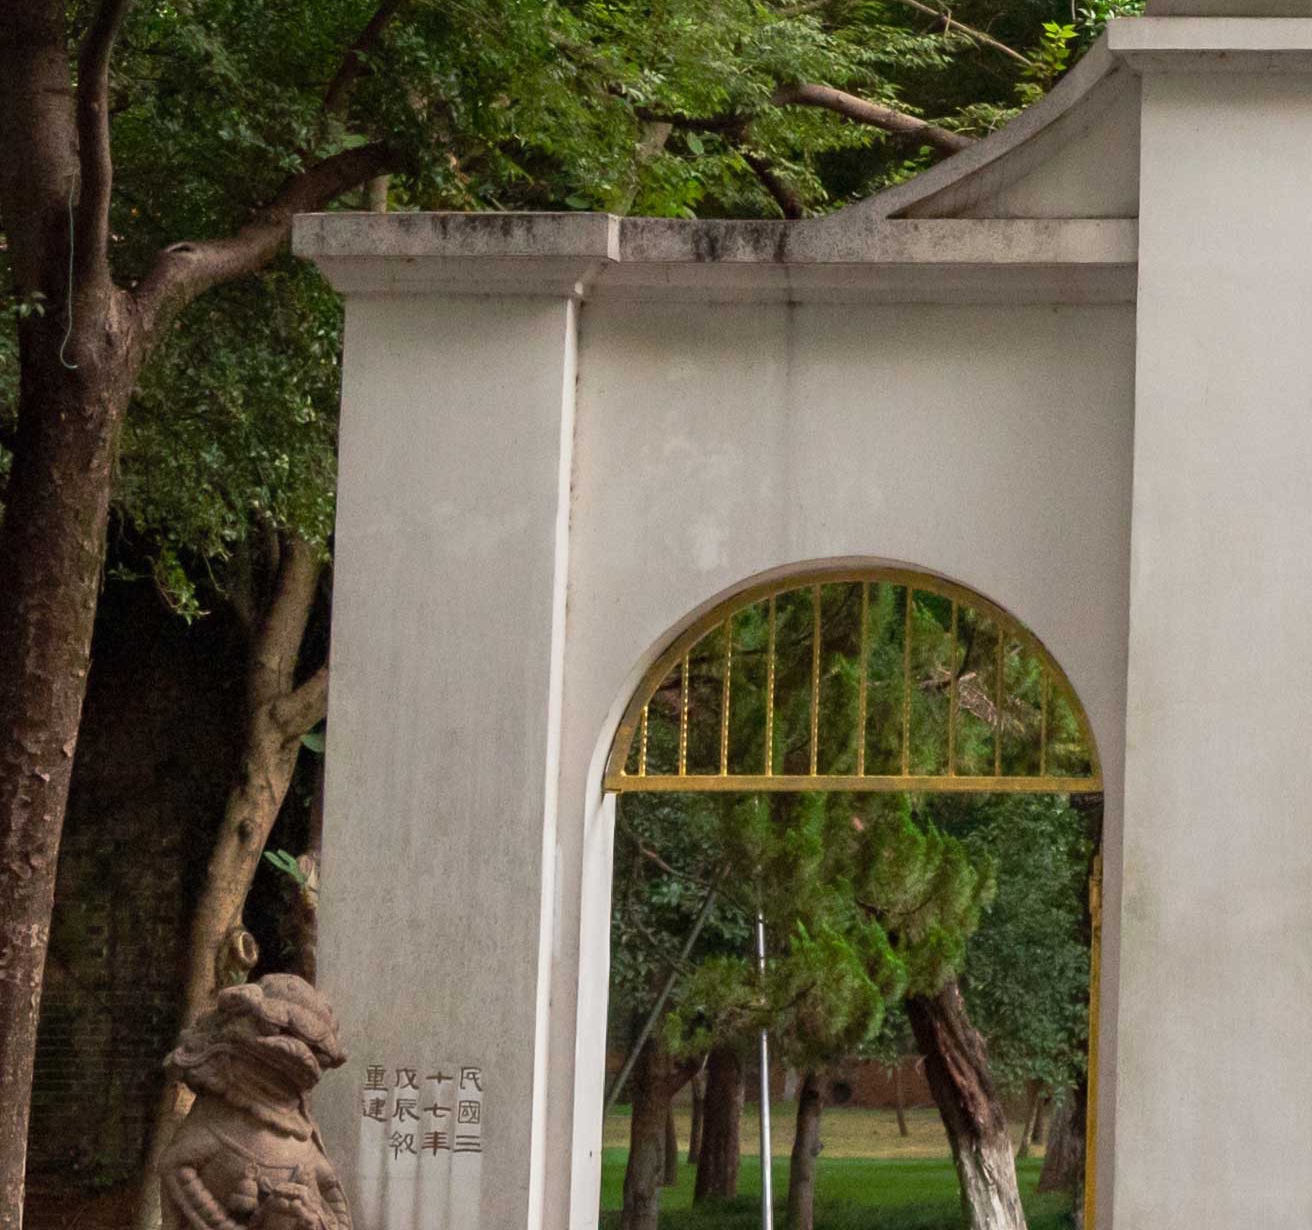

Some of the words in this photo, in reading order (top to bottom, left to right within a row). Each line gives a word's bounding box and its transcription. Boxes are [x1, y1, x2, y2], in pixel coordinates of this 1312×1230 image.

[361, 1064, 388, 1122] 重建
[421, 1071, 454, 1157] 十七年
[453, 1066, 483, 1152] 民國三
